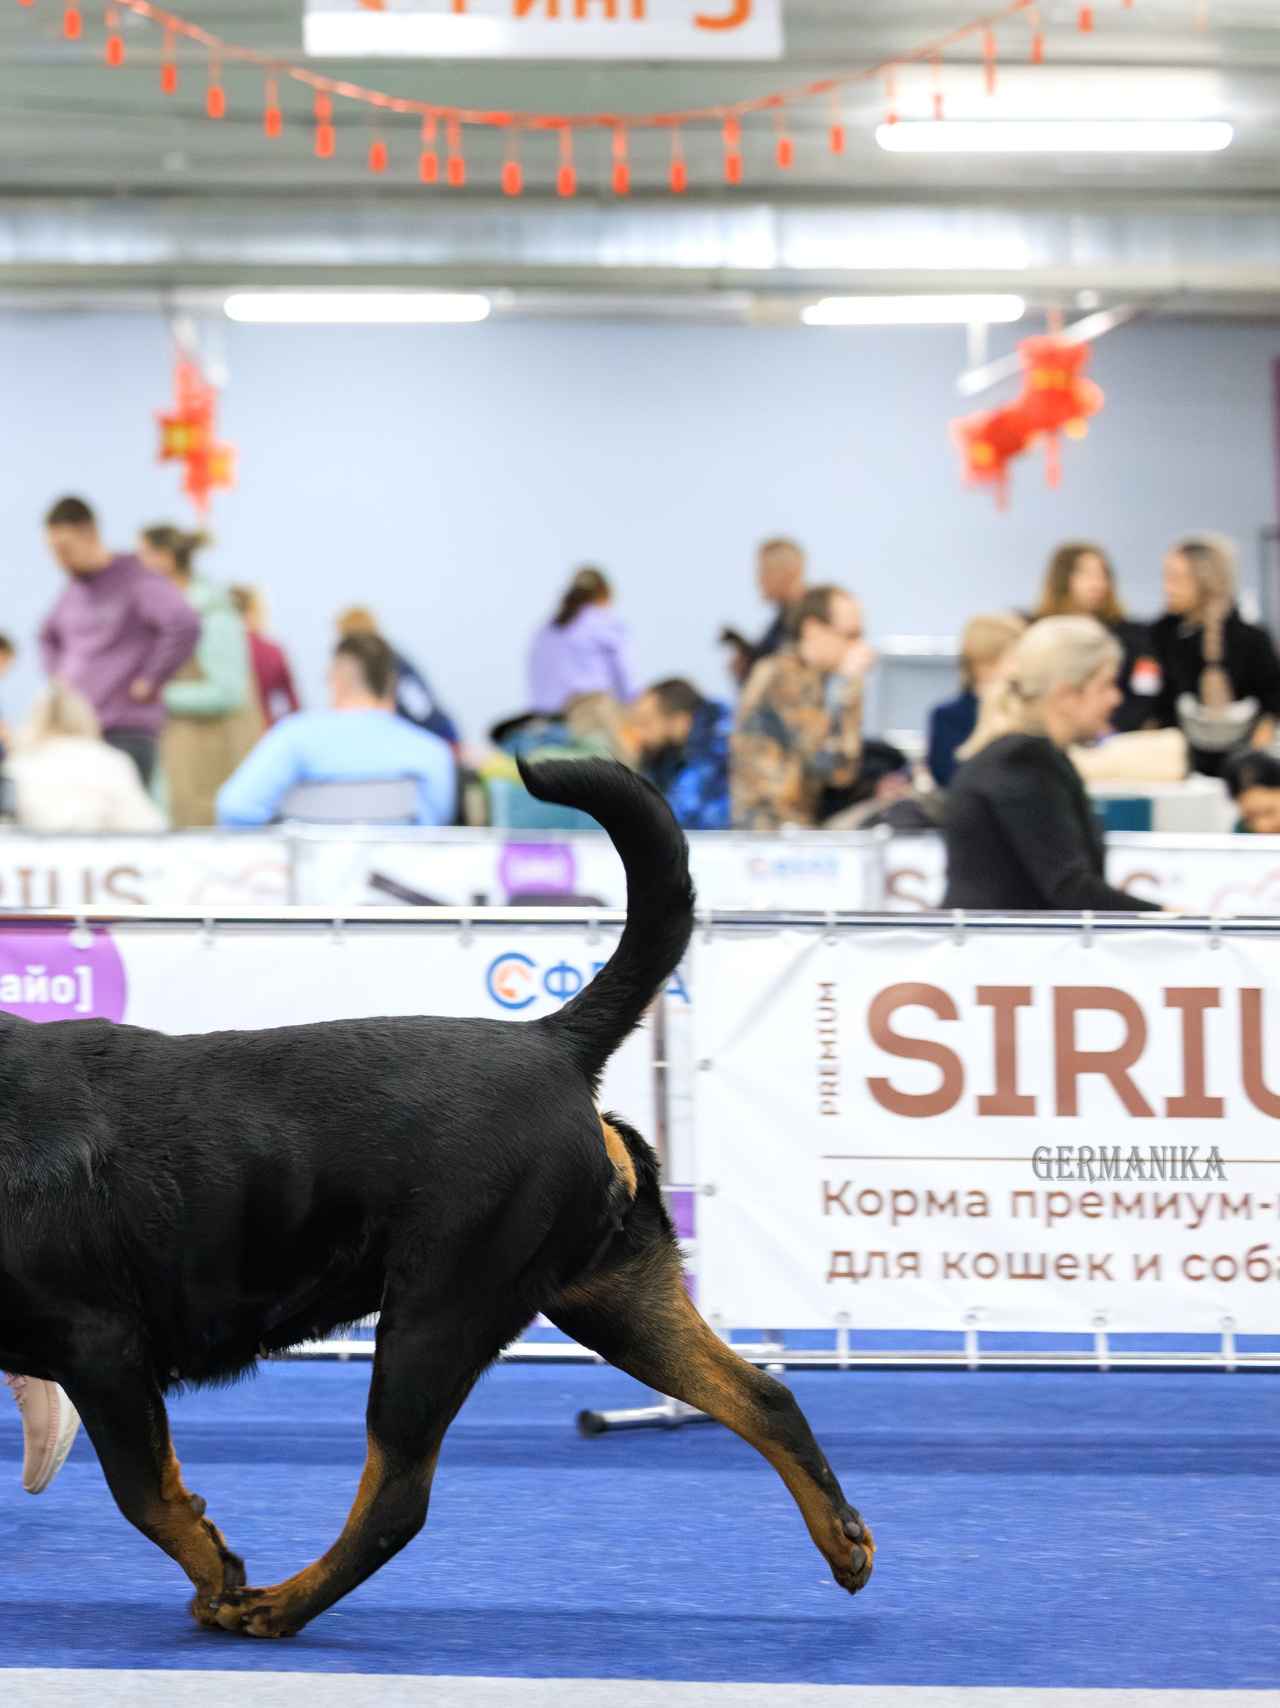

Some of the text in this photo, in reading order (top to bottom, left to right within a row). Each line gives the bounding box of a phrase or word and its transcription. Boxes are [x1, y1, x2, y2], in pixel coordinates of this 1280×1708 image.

[817, 983, 839, 1115] PREMIUM
[822, 1180, 1280, 1230] Корма премиум-
[826, 1244, 1280, 1284] для кошек и соб
